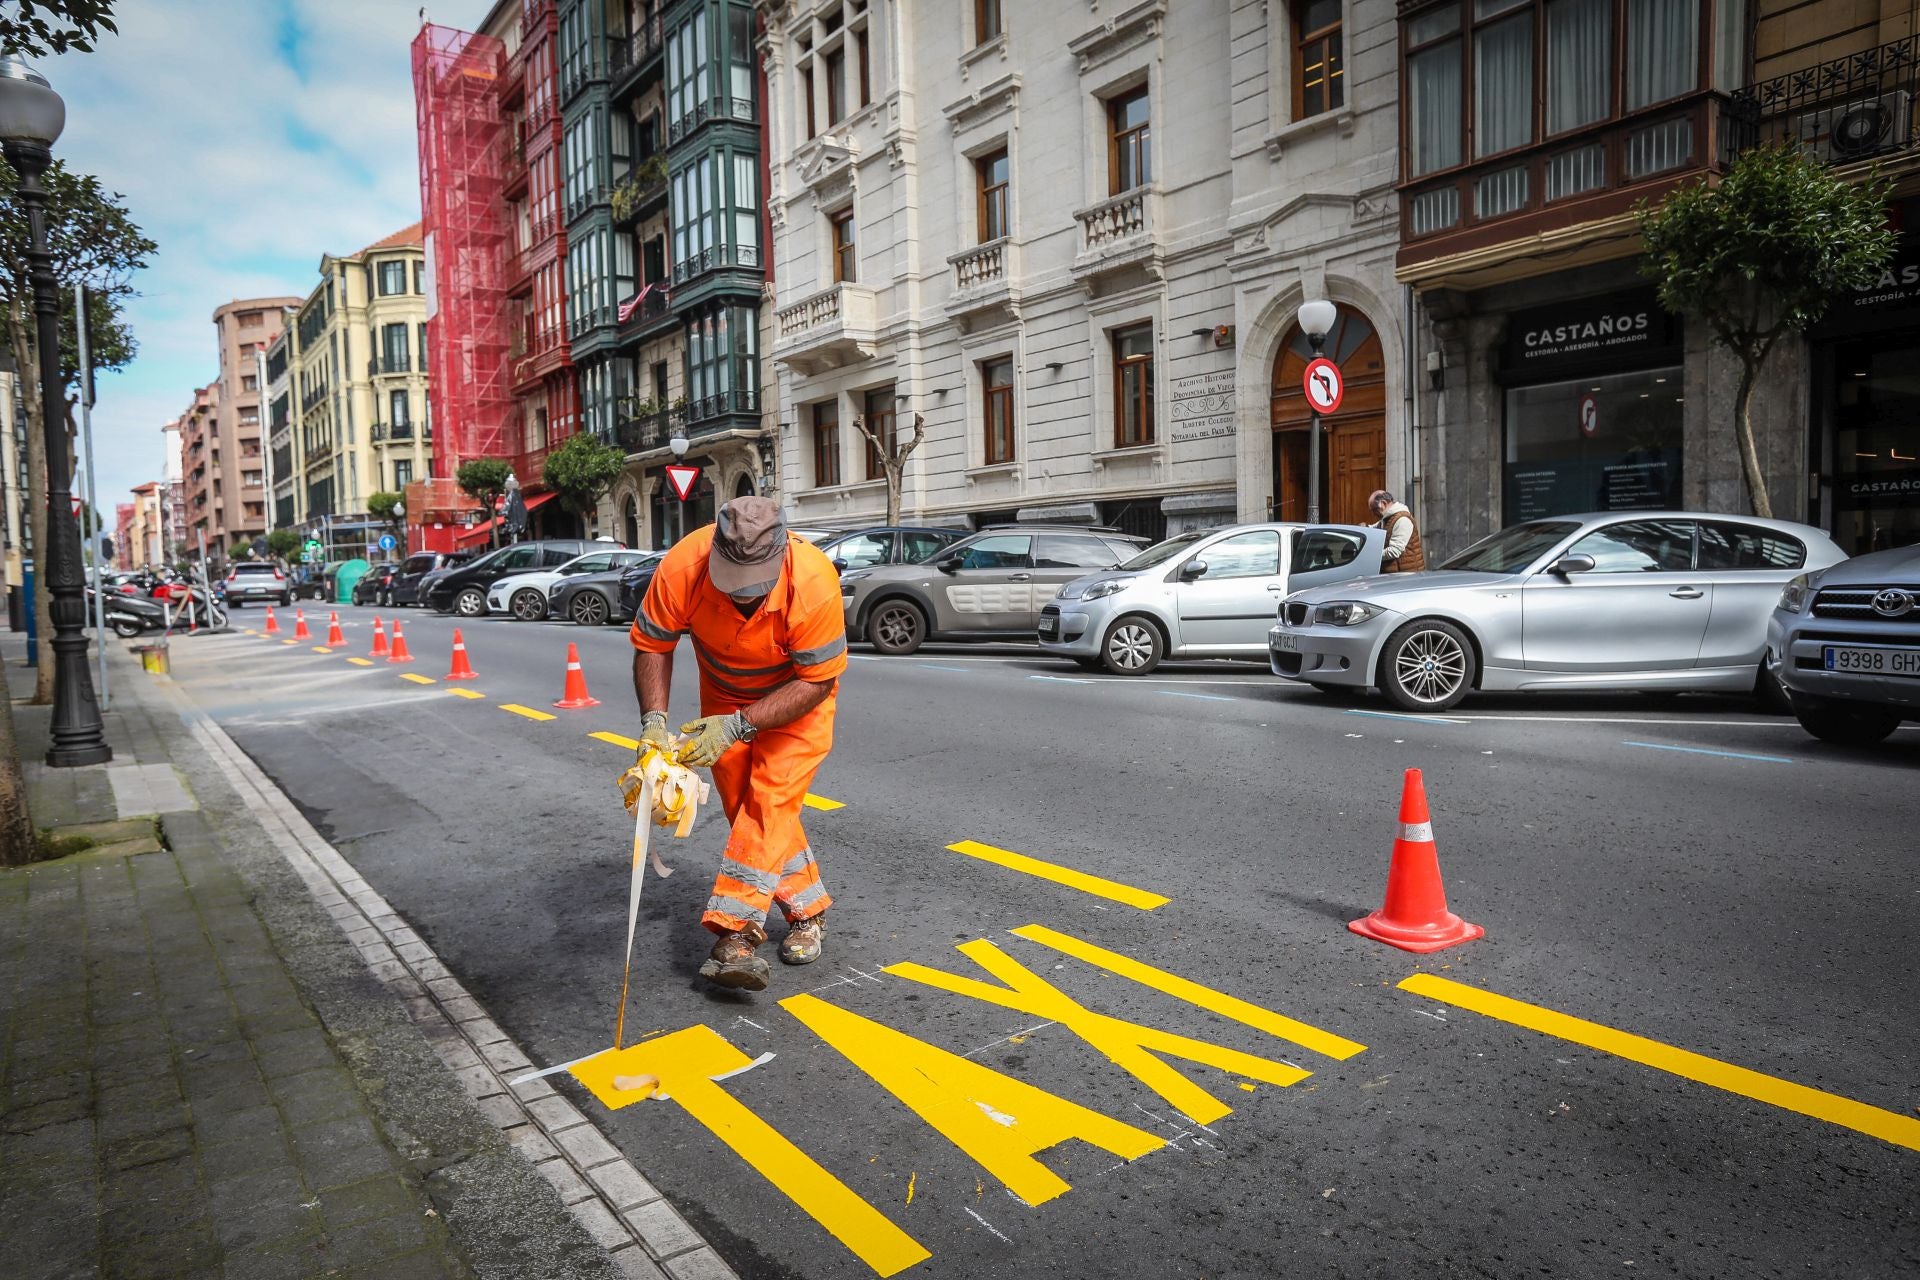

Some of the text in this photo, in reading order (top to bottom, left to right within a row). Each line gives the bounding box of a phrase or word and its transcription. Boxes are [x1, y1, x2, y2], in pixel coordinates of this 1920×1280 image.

[1525, 312, 1648, 347] CASTAÑOS
[1605, 332, 1648, 346] ABOGADOS
[1171, 432, 1198, 441] NOTARIAL
[1839, 651, 1884, 670] 9398
[567, 922, 1368, 1278] TAXI
